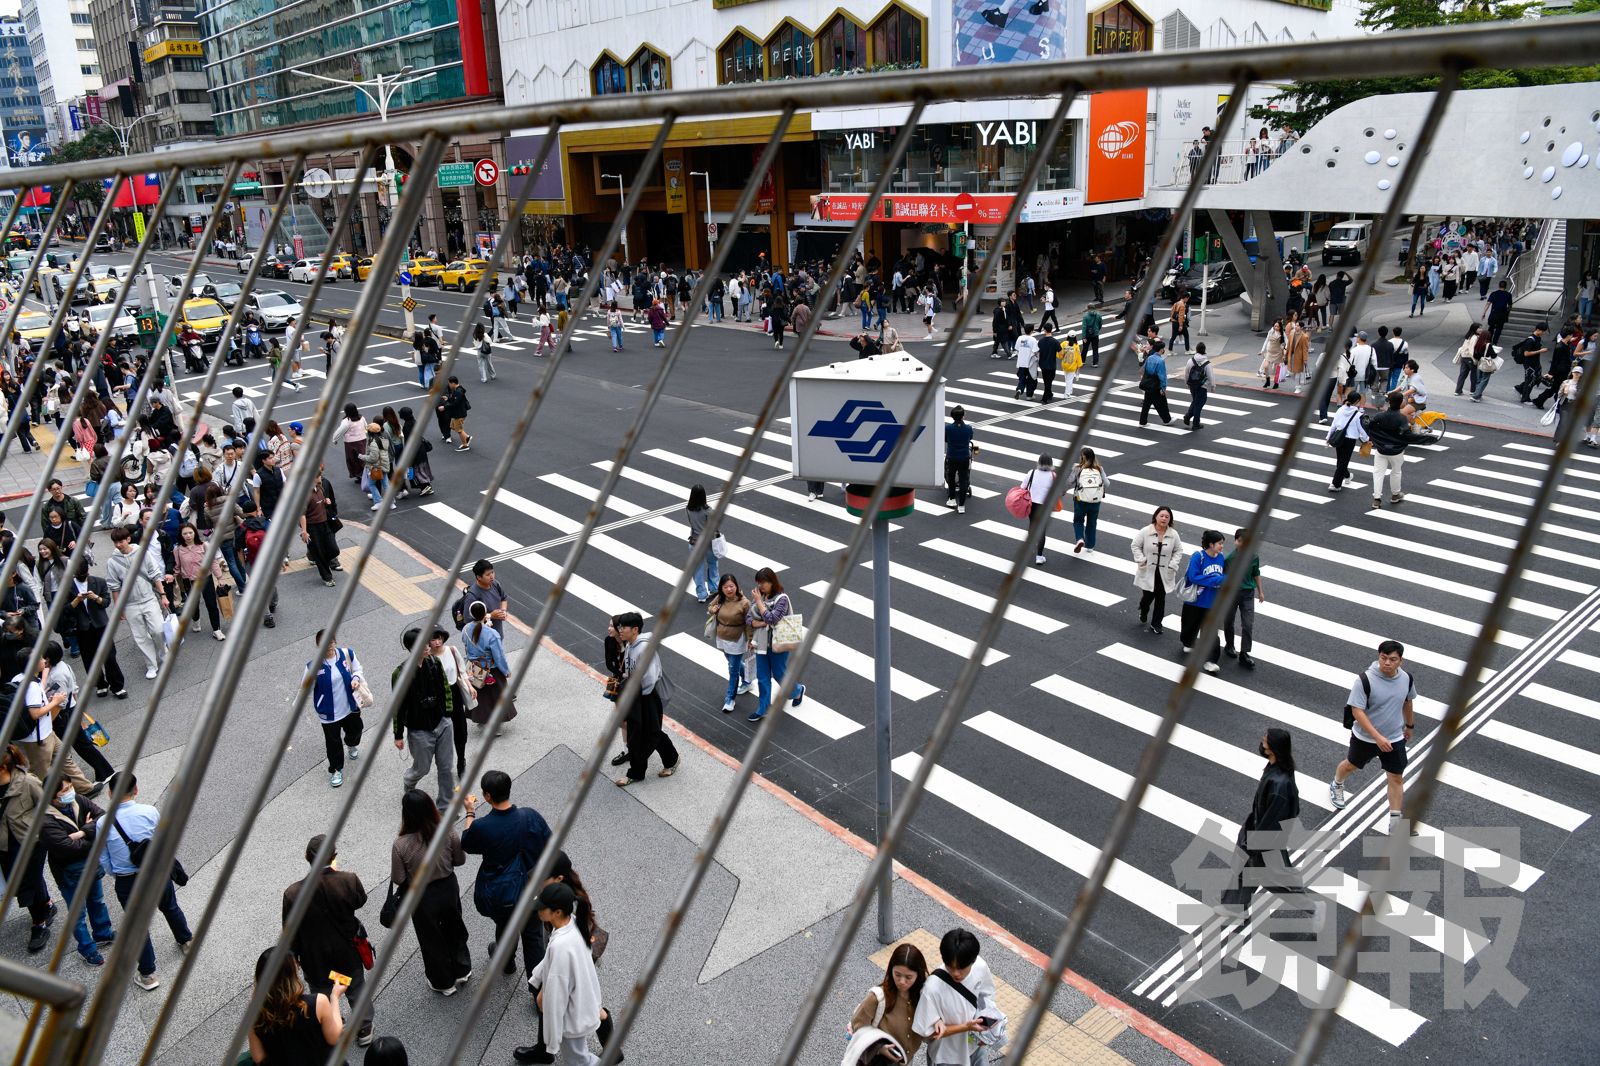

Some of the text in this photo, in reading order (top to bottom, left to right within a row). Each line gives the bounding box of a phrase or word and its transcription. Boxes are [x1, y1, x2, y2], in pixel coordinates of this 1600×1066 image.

[724, 42, 814, 78] FLIPPER'S
[844, 133, 875, 149] YABI
[976, 121, 1036, 146] YABI
[141, 318, 153, 331] 13
